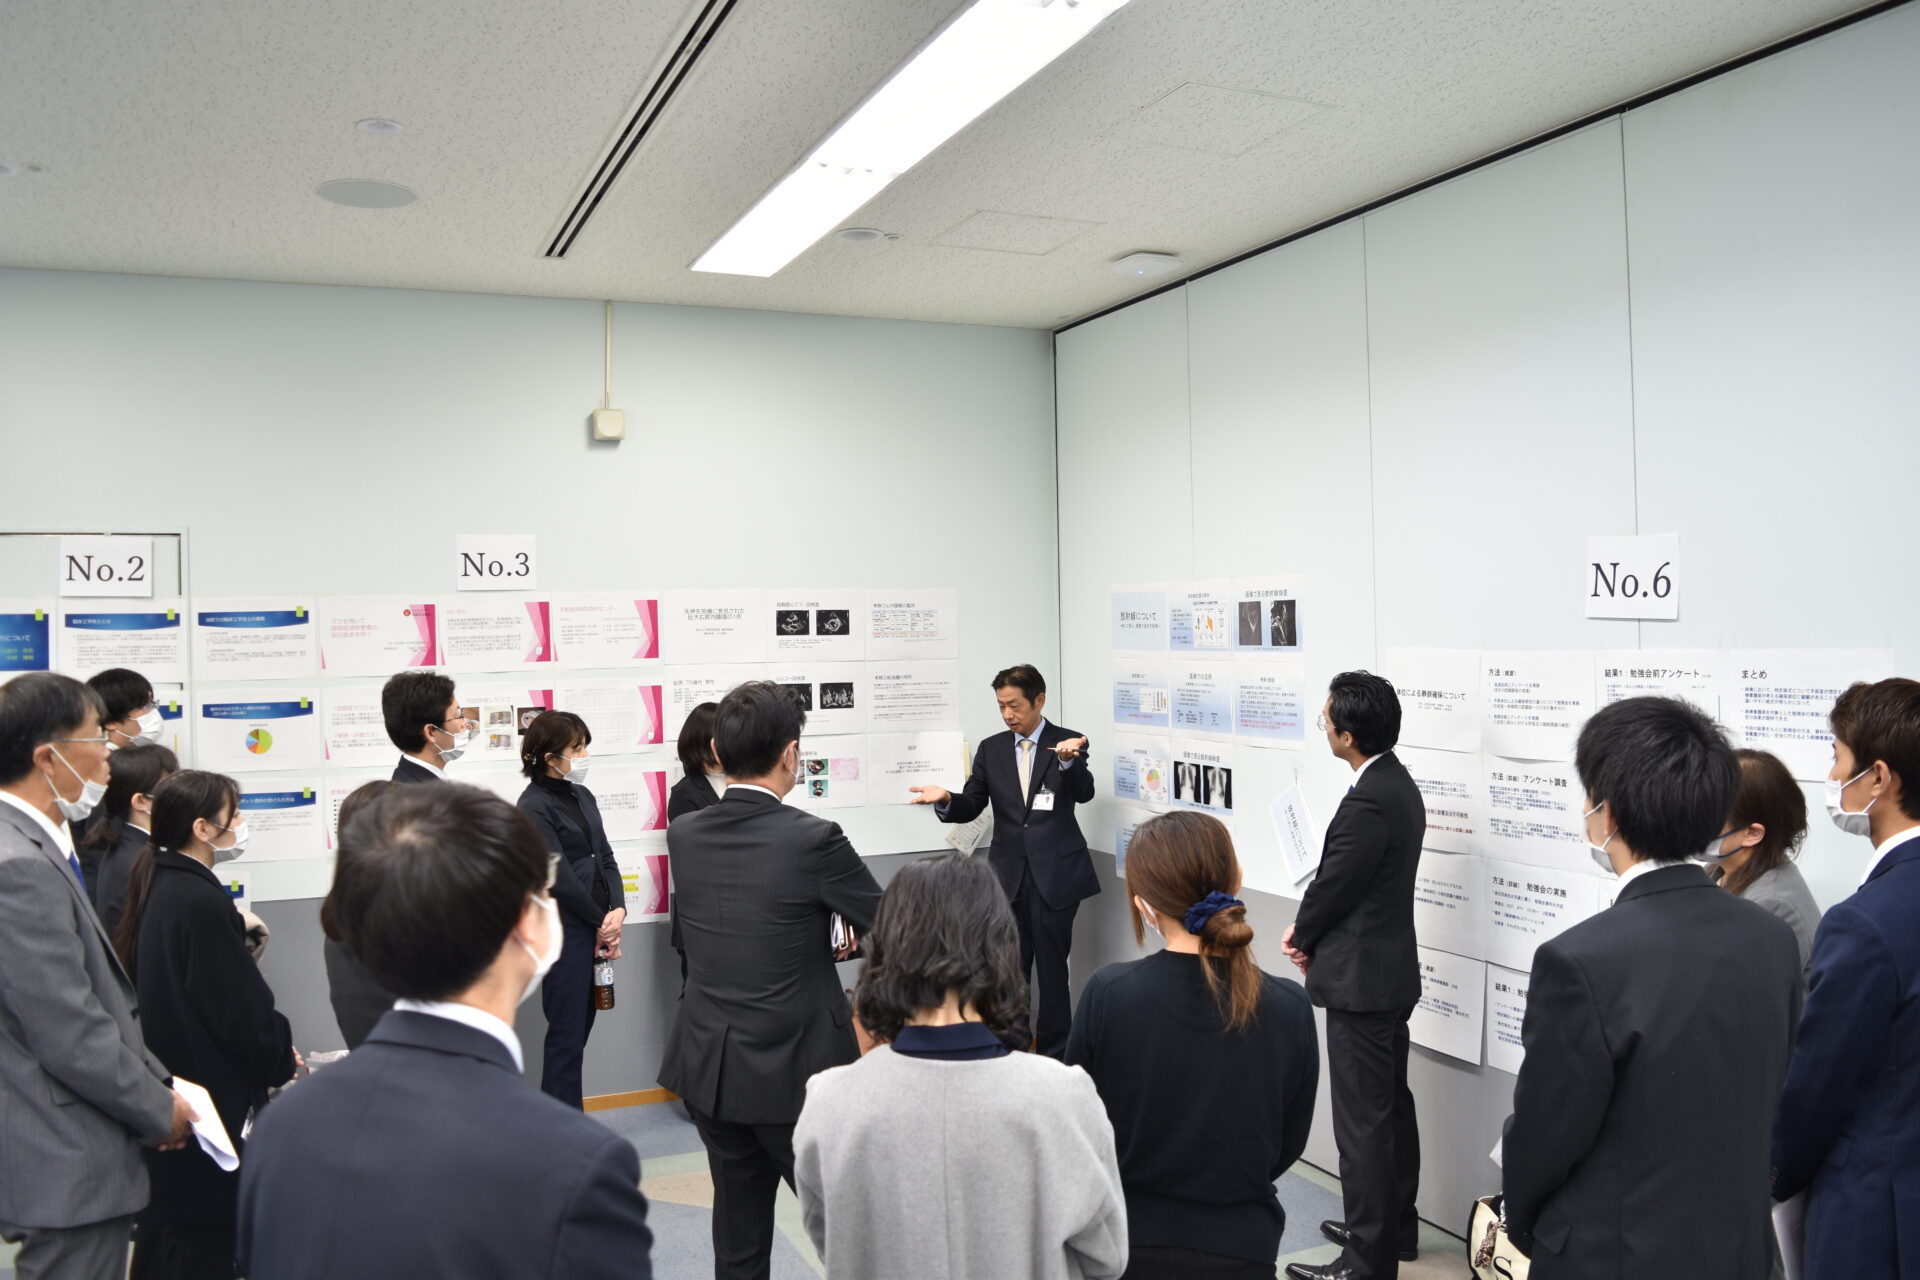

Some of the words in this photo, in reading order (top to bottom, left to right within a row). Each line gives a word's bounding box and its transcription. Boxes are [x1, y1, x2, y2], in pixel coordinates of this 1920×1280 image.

[65, 555, 145, 582] No.2
[461, 552, 530, 577] No.3
[1590, 561, 1672, 598] No.6
[1742, 669, 1768, 680] まとめ
